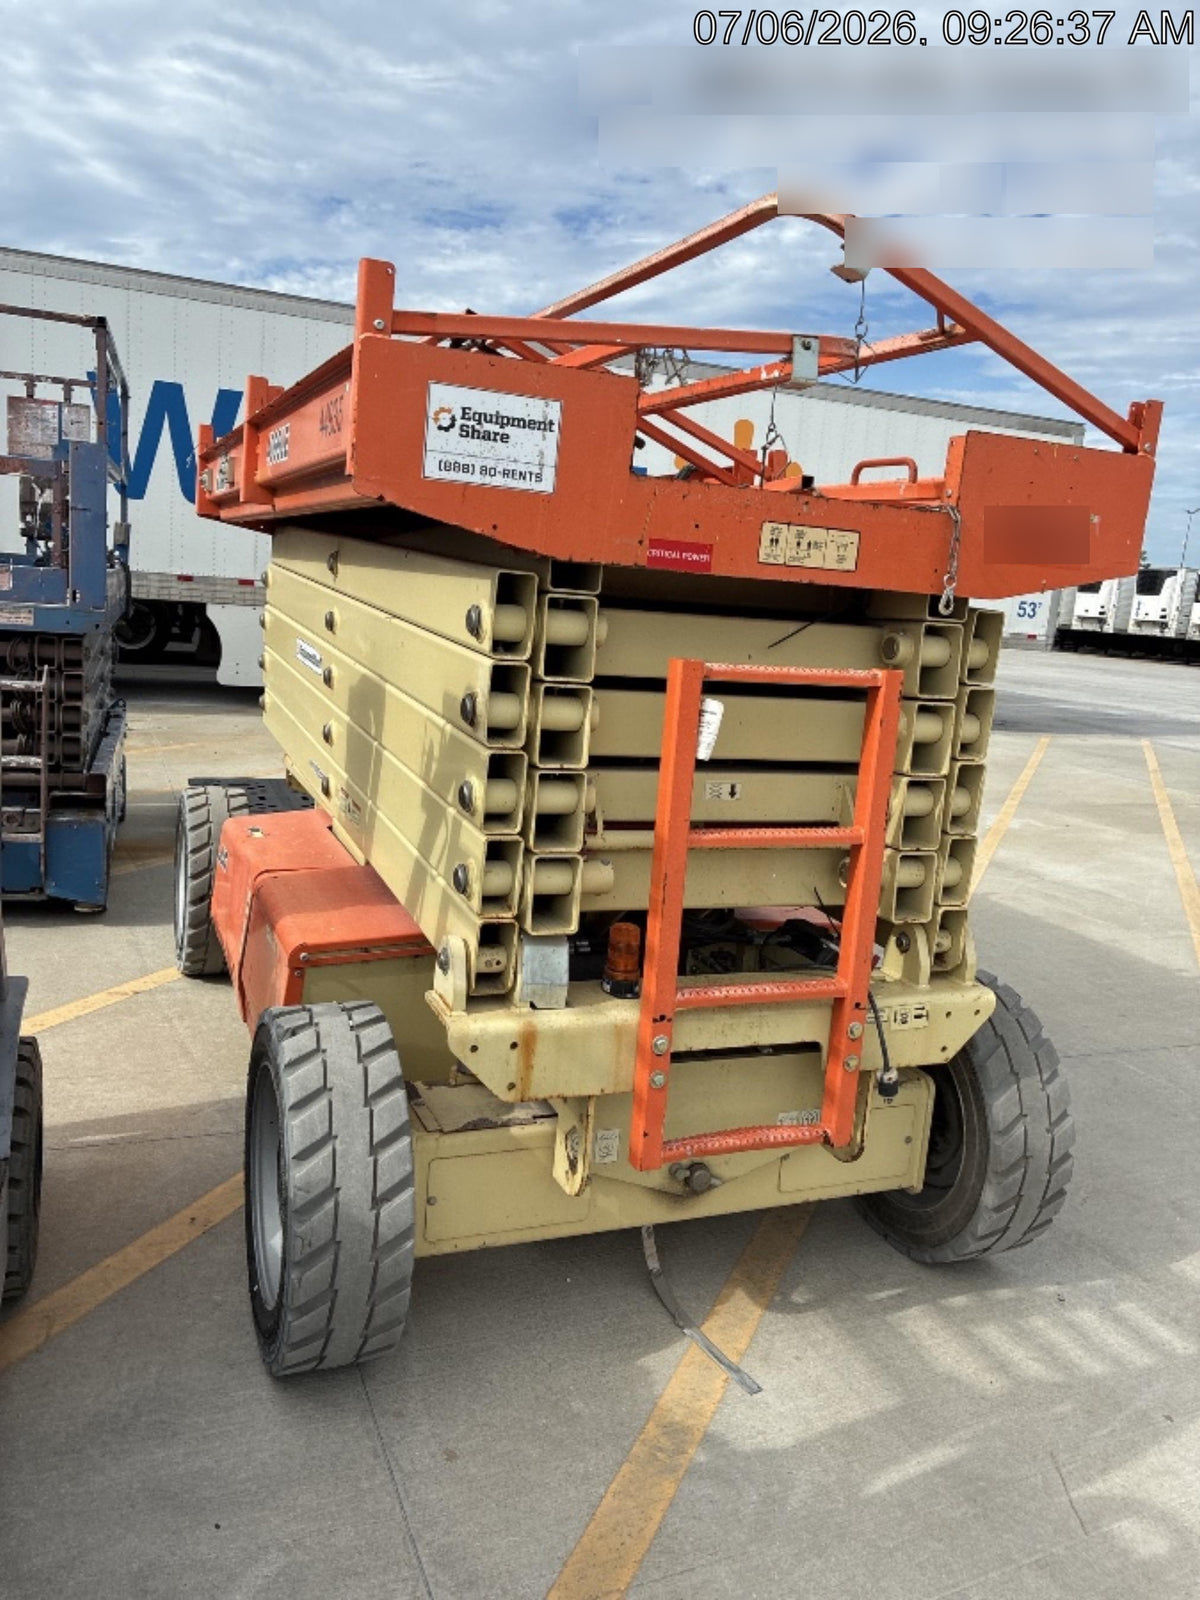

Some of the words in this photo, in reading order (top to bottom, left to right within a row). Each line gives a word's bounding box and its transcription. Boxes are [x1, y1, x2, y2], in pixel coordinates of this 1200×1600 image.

[460, 406, 556, 433] Equipment
[458, 424, 511, 444] Share
[438, 459, 475, 475] (888)
[479, 464, 543, 483] 80-RENTS
[646, 549, 680, 559] CRITICAL
[682, 552, 710, 562] POWER
